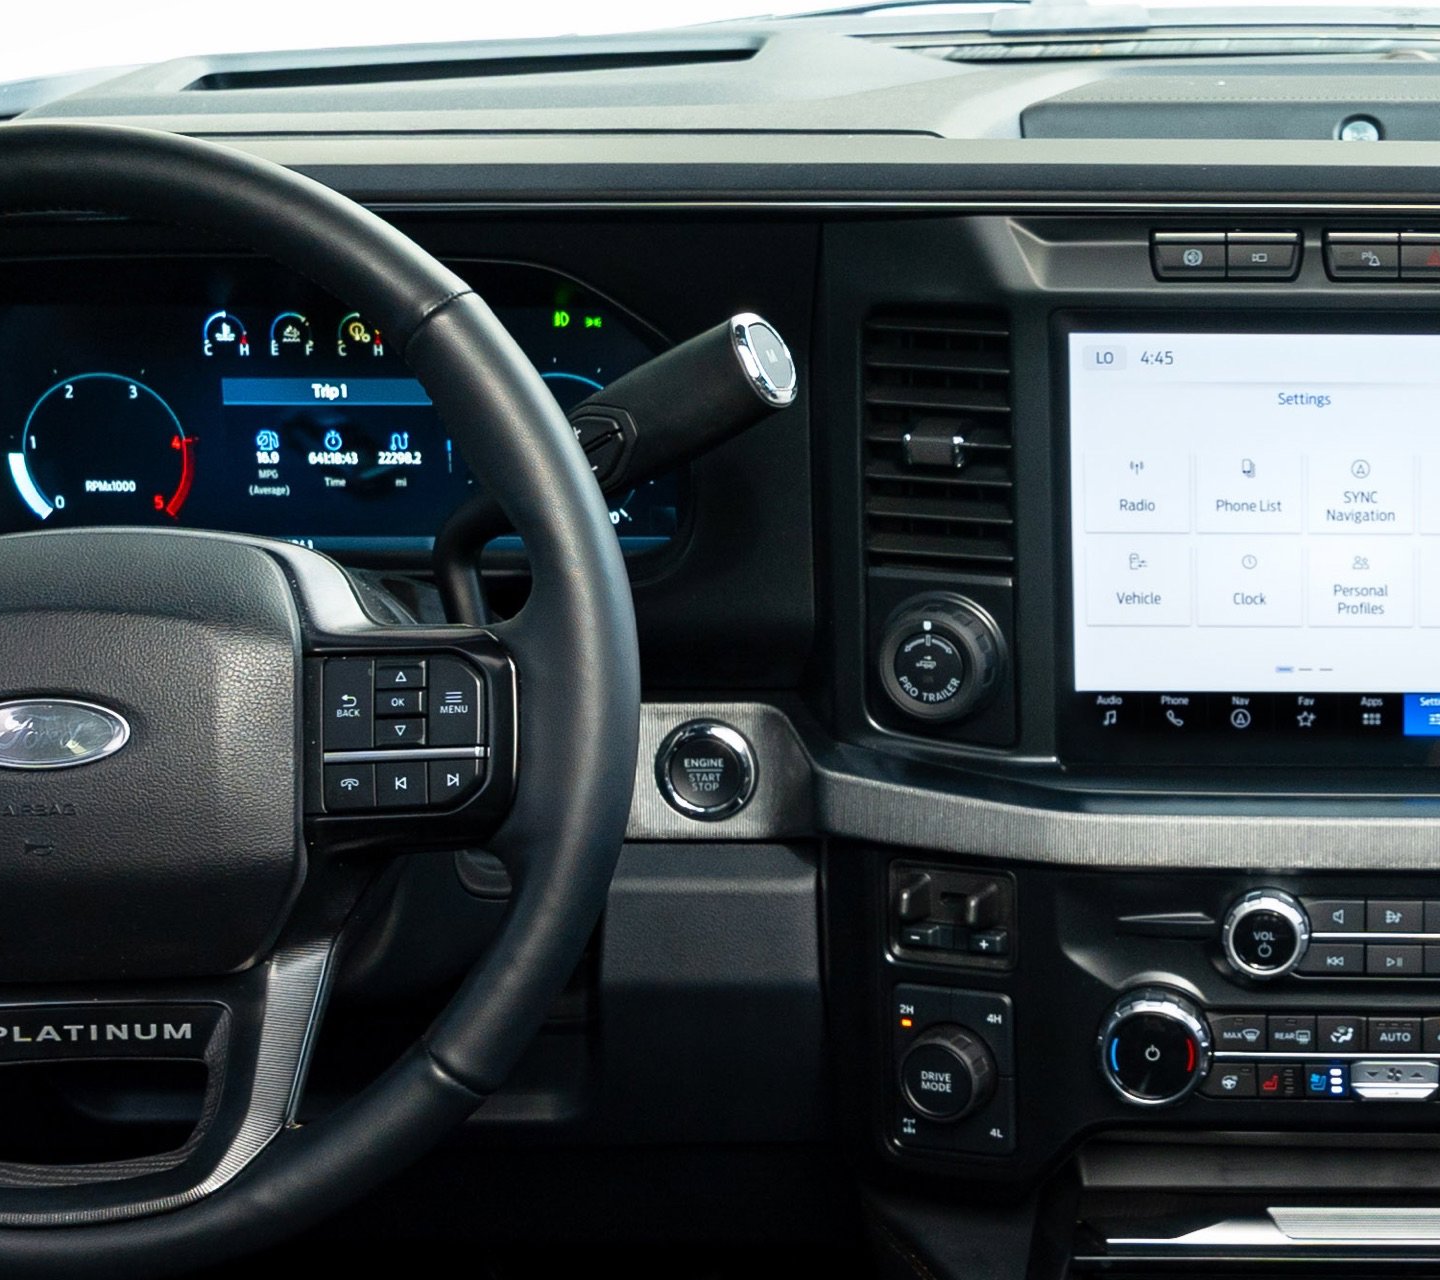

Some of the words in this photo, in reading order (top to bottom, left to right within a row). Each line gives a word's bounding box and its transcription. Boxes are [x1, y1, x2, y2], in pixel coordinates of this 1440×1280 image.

[203, 344, 213, 356] C
[239, 344, 250, 356] H
[270, 344, 280, 356] E
[305, 344, 314, 356] F
[338, 344, 347, 356] C
[373, 344, 384, 356] H
[1095, 351, 1114, 365] LO
[1140, 350, 1174, 366] 4:45
[64, 385, 74, 399] 2
[129, 385, 138, 399] 3
[311, 383, 340, 400] Trip
[341, 384, 348, 399] 1
[1277, 392, 1332, 408] Settings
[29, 435, 37, 450] 1
[171, 435, 181, 450] 4
[258, 469, 279, 480] MPG
[85, 480, 136, 492] RPMx1000
[324, 477, 347, 487] Time
[395, 477, 408, 487] mi
[249, 484, 291, 496] (Average)
[54, 495, 65, 509] 0
[153, 495, 164, 509] 5
[1343, 491, 1379, 505] SYNC
[1119, 499, 1156, 512] Radio
[1216, 499, 1257, 513] Phone
[1259, 499, 1283, 513] List
[1326, 509, 1396, 524] Navigation
[1333, 584, 1389, 597] Personal
[1116, 592, 1161, 605] Vehicle
[1233, 592, 1267, 605] Clock
[1337, 602, 1385, 615] Profiles
[899, 675, 919, 697] PRO
[922, 677, 960, 702] TRAILER
[391, 698, 405, 707] OK
[1097, 695, 1122, 706] Audio
[1161, 695, 1189, 706] Phone
[1232, 695, 1250, 706] Nav
[1298, 696, 1315, 706] Fav
[1360, 696, 1383, 708] Apps
[336, 708, 360, 718] BACK
[439, 705, 469, 714] MENU
[683, 758, 725, 768] ENGINE
[688, 773, 721, 782] START
[691, 782, 720, 791] STOP
[1253, 931, 1276, 941] VOL
[899, 1004, 914, 1015] 2H
[986, 1013, 1002, 1024] 4H
[1223, 1031, 1243, 1040] MAX
[1274, 1031, 1296, 1040] REAR
[1379, 1032, 1411, 1042] AUTO
[920, 1070, 952, 1083] DRIVE
[921, 1081, 952, 1093] MODE
[989, 1128, 1004, 1138] 4L
